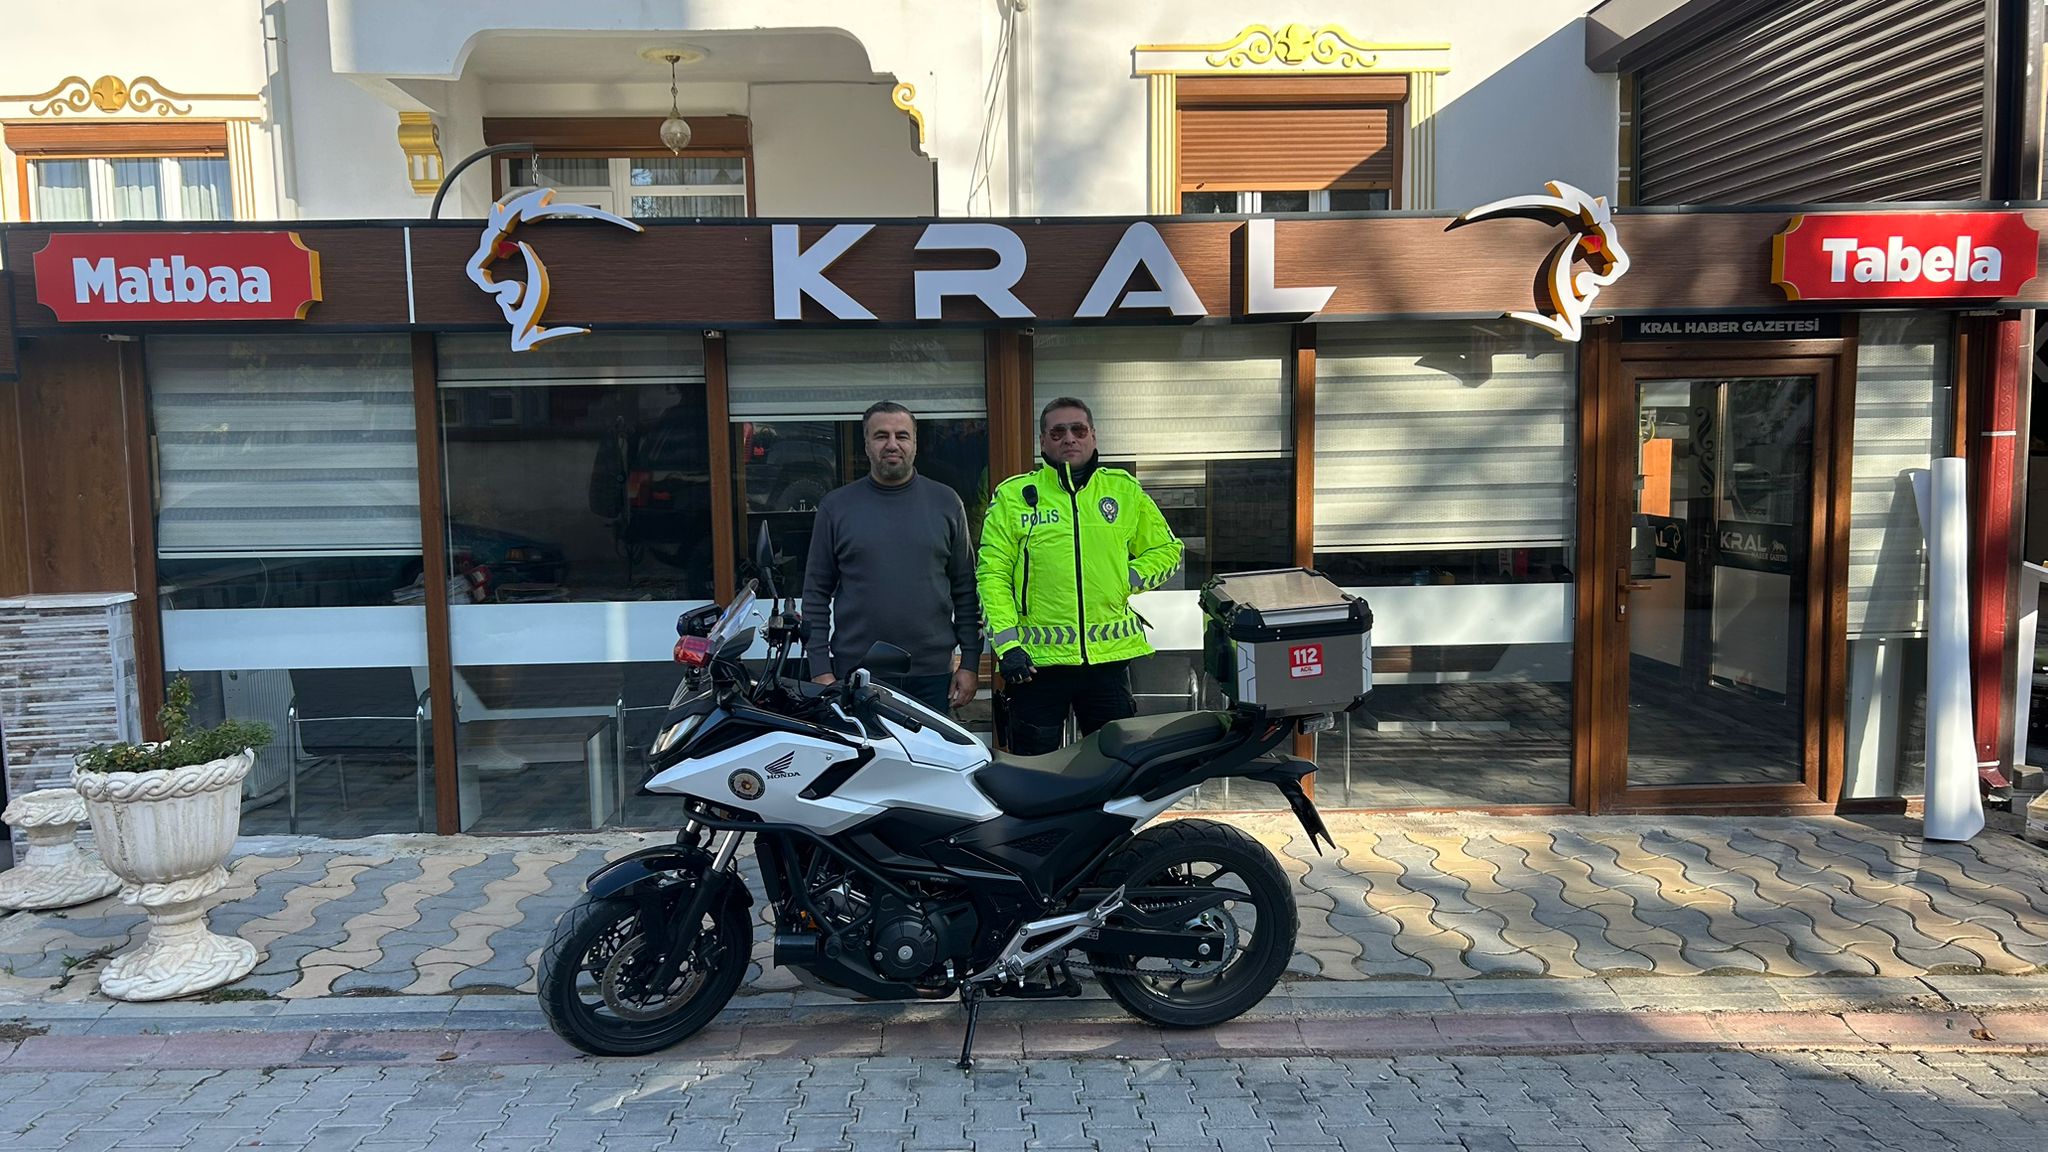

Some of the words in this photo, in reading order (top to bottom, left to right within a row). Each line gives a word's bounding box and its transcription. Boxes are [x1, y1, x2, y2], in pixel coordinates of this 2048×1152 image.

[771, 218, 1337, 320] KRAL
[1822, 235, 2002, 283] Tabela
[72, 255, 272, 304] Matbaa
[1639, 322, 1682, 334] KRAL
[1685, 321, 1739, 333] HABER
[1742, 317, 1820, 332] GAZETESİ
[1720, 530, 1767, 552] KRAL
[1294, 647, 1317, 665] 112
[767, 771, 801, 779] HONDA
